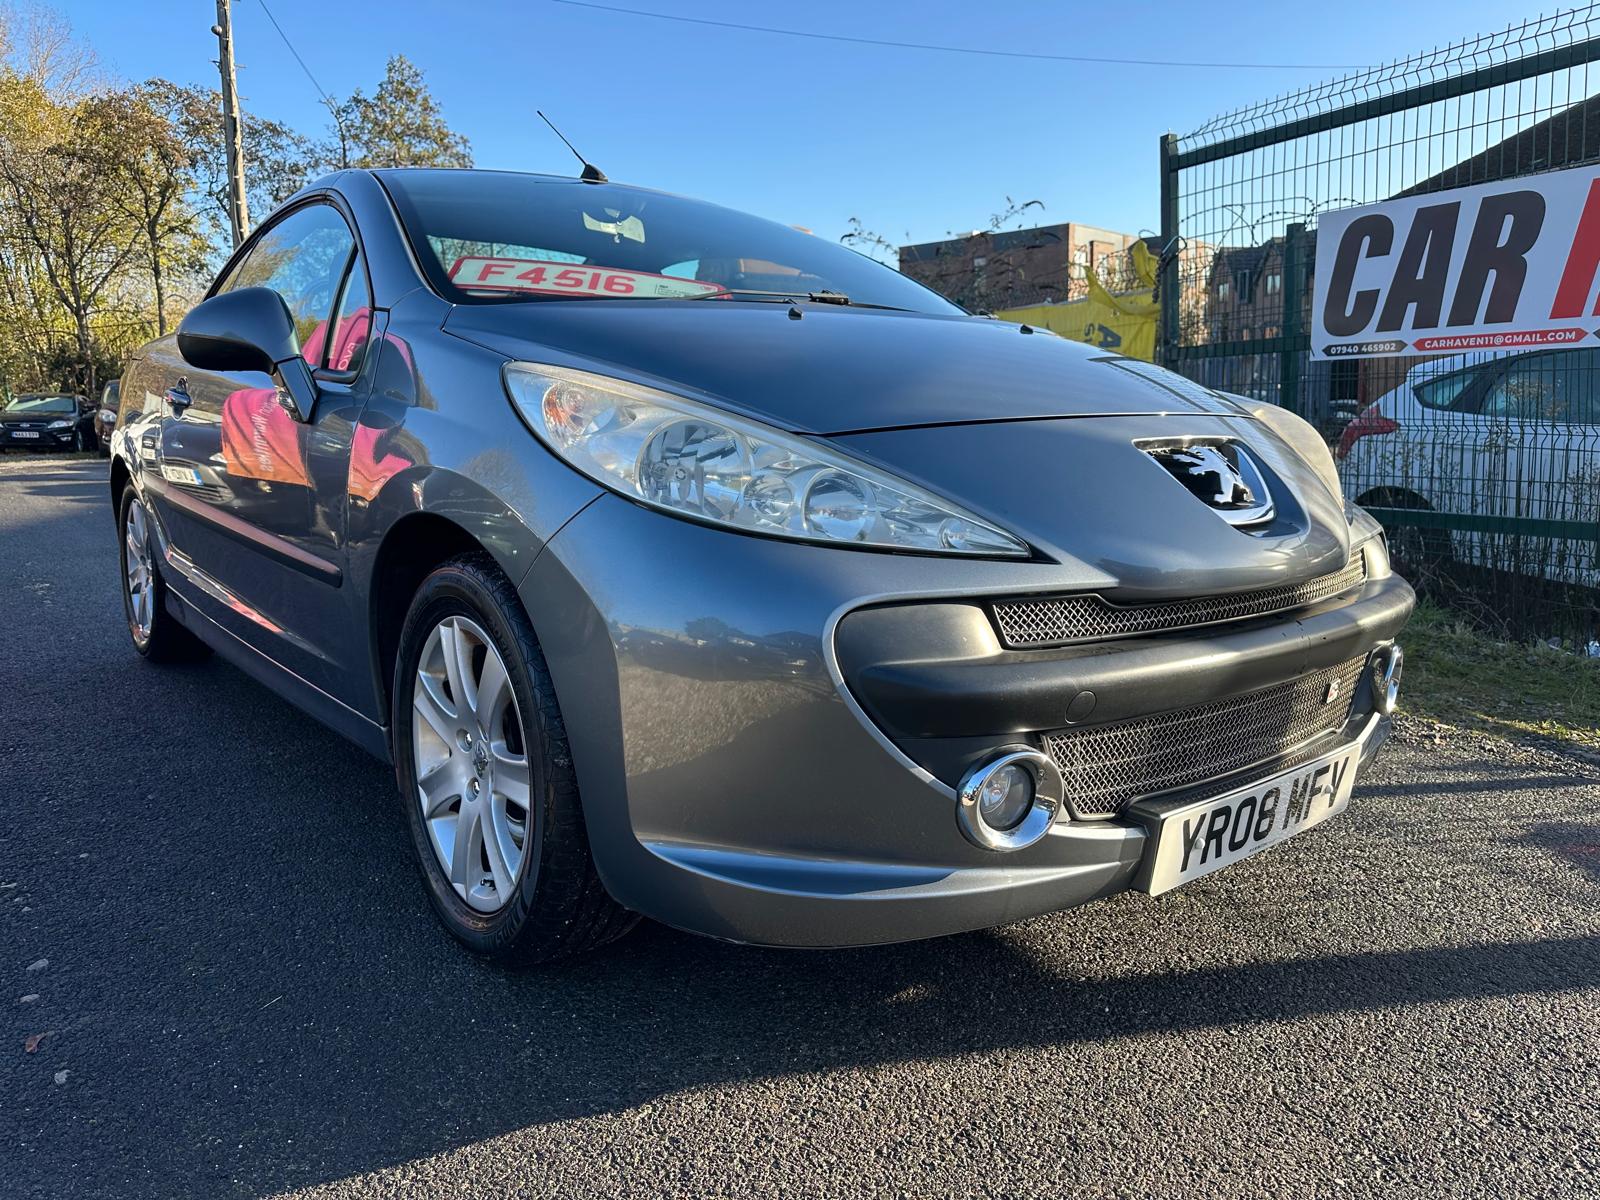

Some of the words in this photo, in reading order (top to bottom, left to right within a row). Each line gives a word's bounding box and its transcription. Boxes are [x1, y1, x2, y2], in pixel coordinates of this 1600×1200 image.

[1323, 190, 1546, 337] CAR
[1331, 344, 1358, 354] 07940
[1361, 342, 1396, 353] 465902
[1424, 331, 1576, 348] CARHAVEN11@GMAIL.COM
[1180, 786, 1281, 873] YR08
